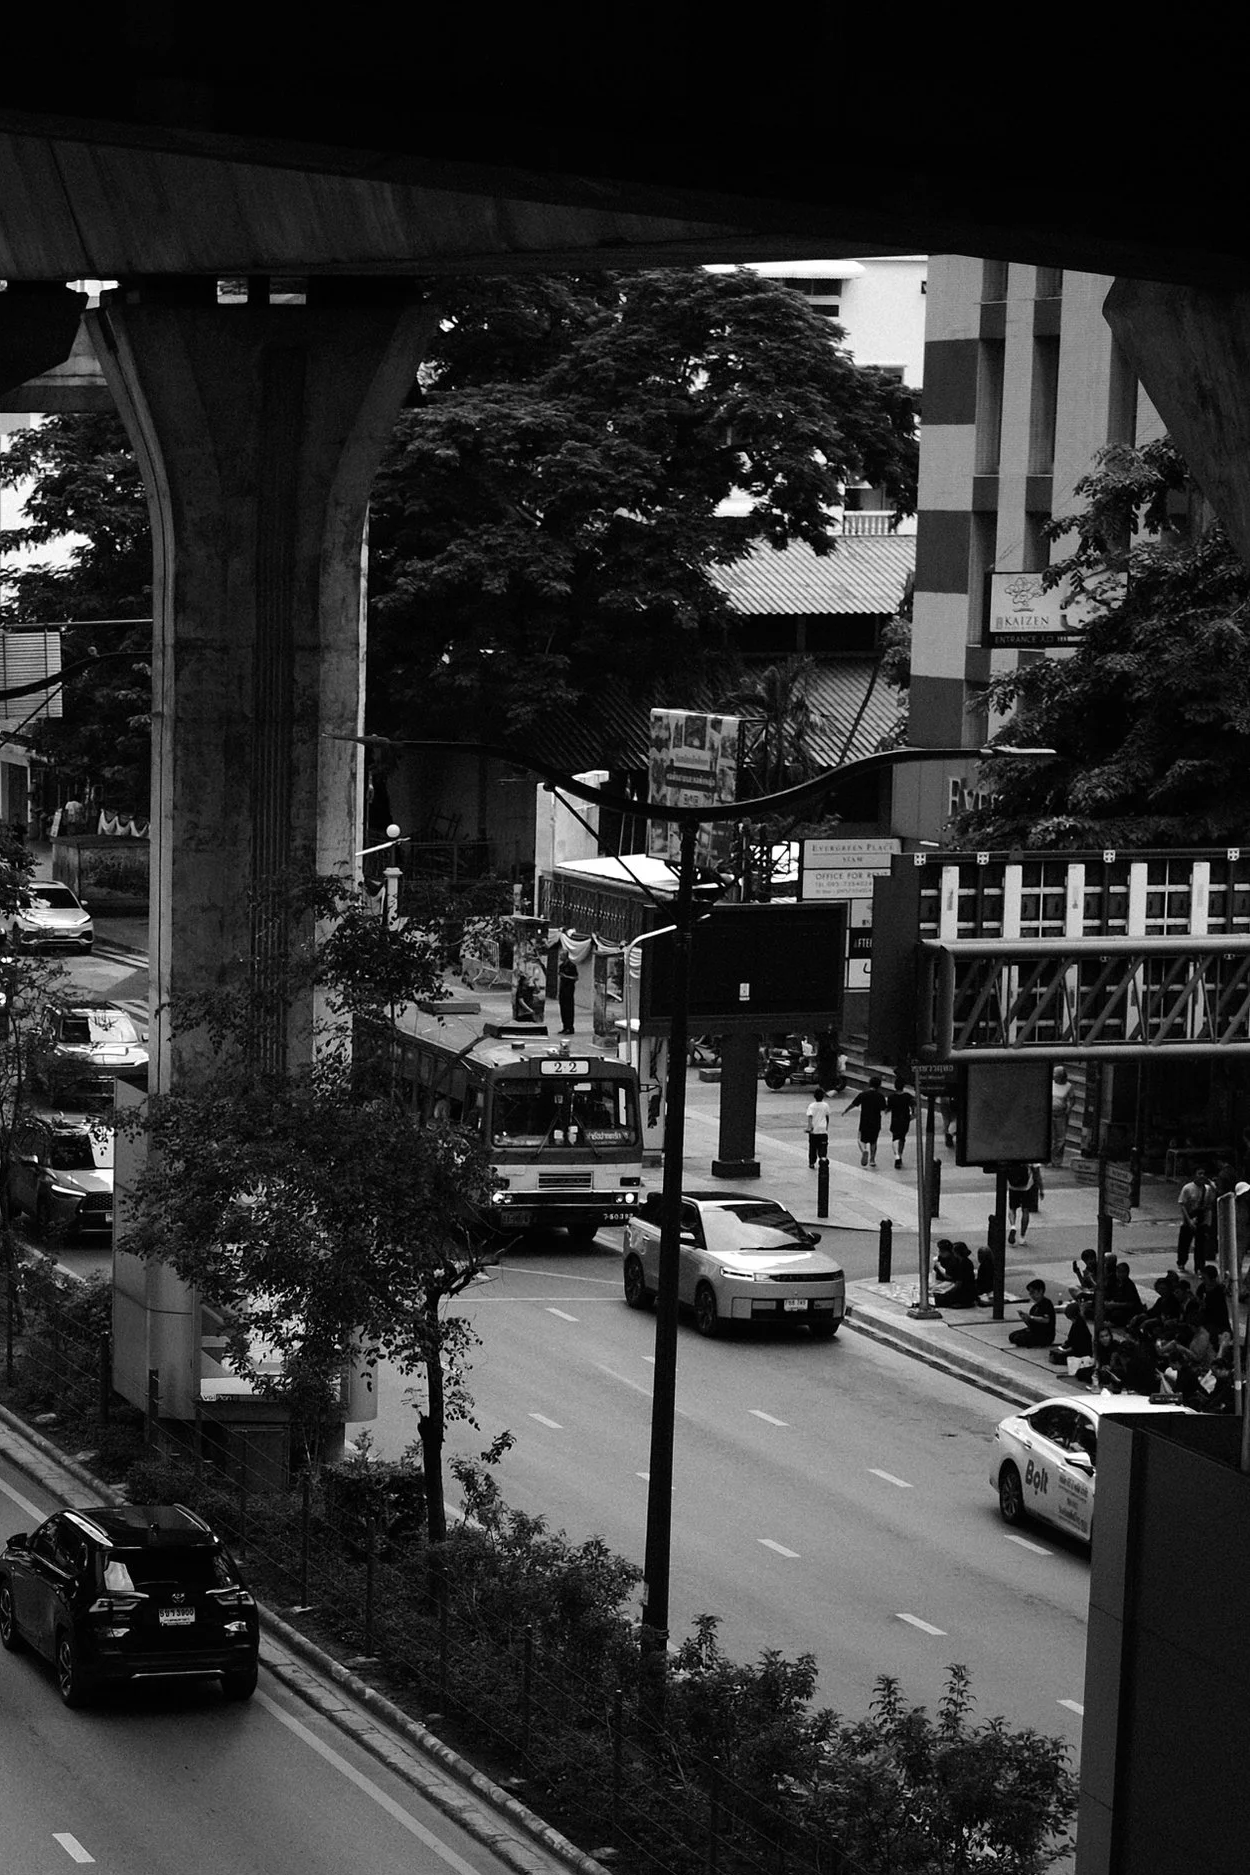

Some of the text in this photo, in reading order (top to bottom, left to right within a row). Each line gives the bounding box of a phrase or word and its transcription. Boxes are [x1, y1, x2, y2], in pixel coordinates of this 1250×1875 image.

[1005, 615, 1049, 626] KAIZEN
[994, 635, 1036, 644] ENTRANCE
[815, 872, 843, 880] OFFICE
[1026, 1459, 1048, 1495] Bolt
